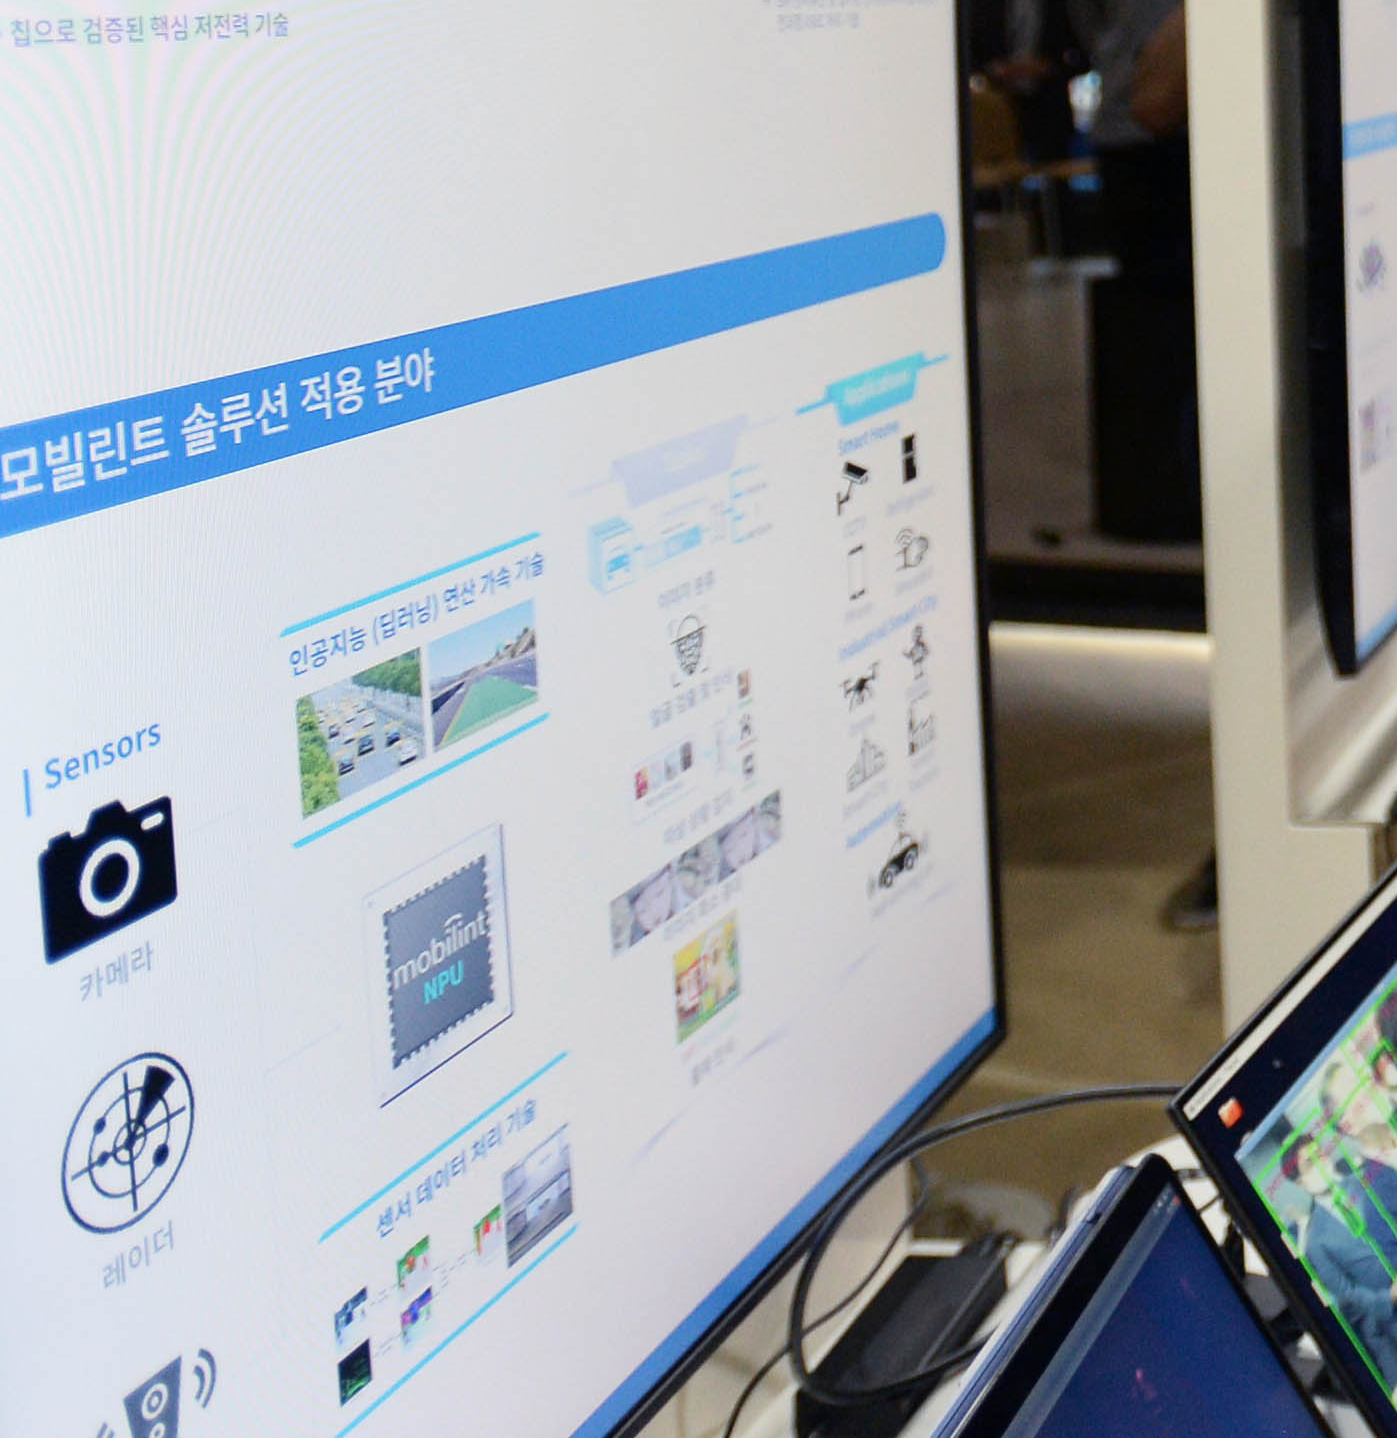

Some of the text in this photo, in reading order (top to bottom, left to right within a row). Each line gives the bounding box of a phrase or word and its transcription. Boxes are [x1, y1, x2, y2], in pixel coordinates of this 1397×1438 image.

[10, 11, 289, 48] 칩으로 검증된 핵심 저전력 기술
[0, 347, 435, 501] 모빌린트 솔루션 적용 분야
[289, 552, 545, 677] 인공지능 (딥러닝) 연산 가속 기술
[44, 722, 162, 790] Sensors
[79, 939, 155, 1003] 카메라
[393, 910, 488, 990] mobilint
[423, 961, 465, 1005] NPU
[376, 1189, 413, 1239] 센서
[416, 1148, 468, 1205] 데이터
[102, 1219, 175, 1290] 레이더
